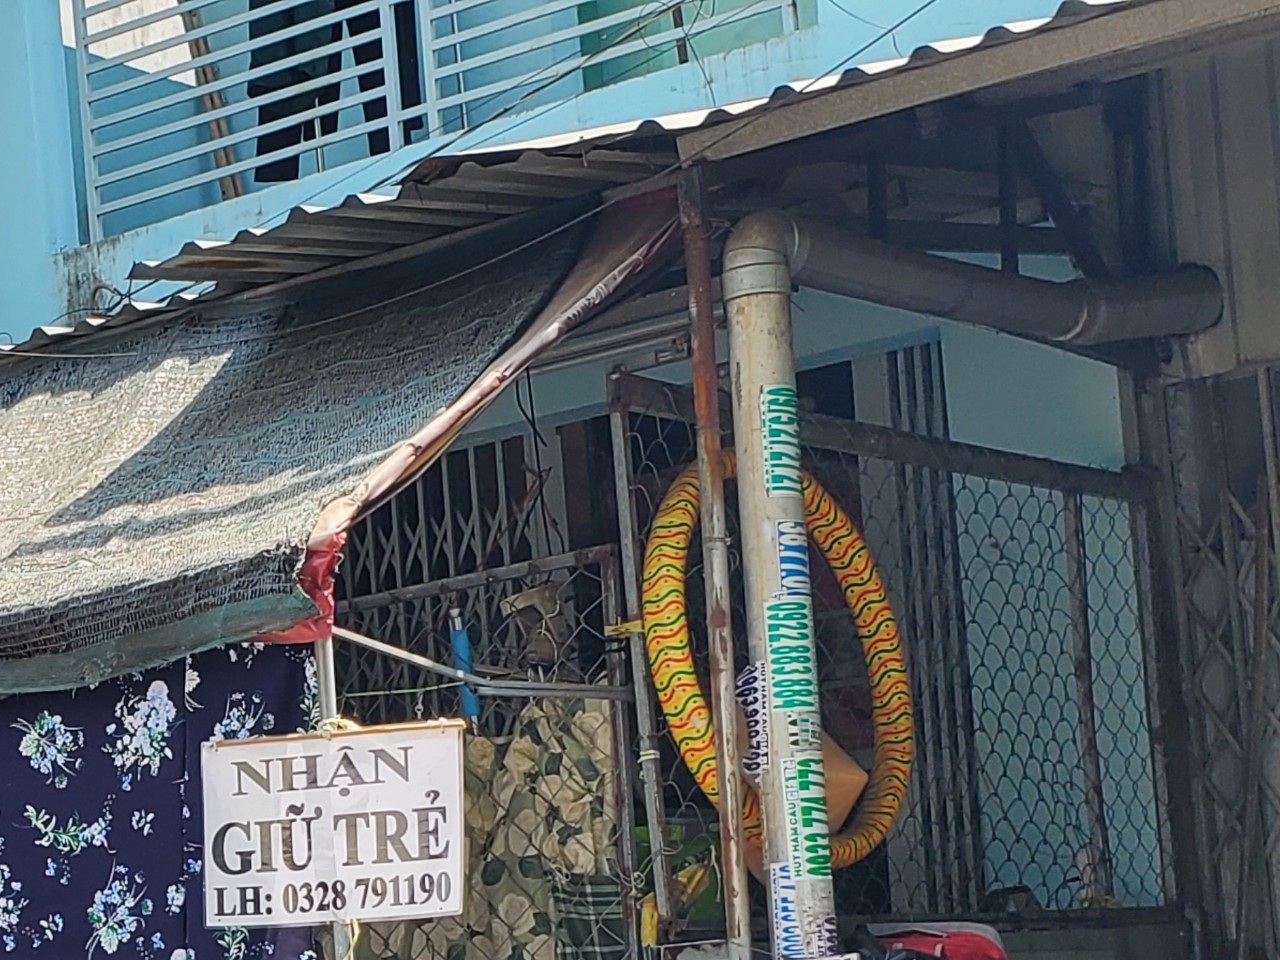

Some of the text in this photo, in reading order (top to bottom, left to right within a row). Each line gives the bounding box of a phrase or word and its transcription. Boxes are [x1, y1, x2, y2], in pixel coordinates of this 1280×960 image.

[766, 602, 815, 710] 0922.883.884
[231, 745, 413, 797] NHẬN
[211, 789, 450, 876] GIỮ TRẺ
[213, 871, 452, 917] LH: 0328 791190
